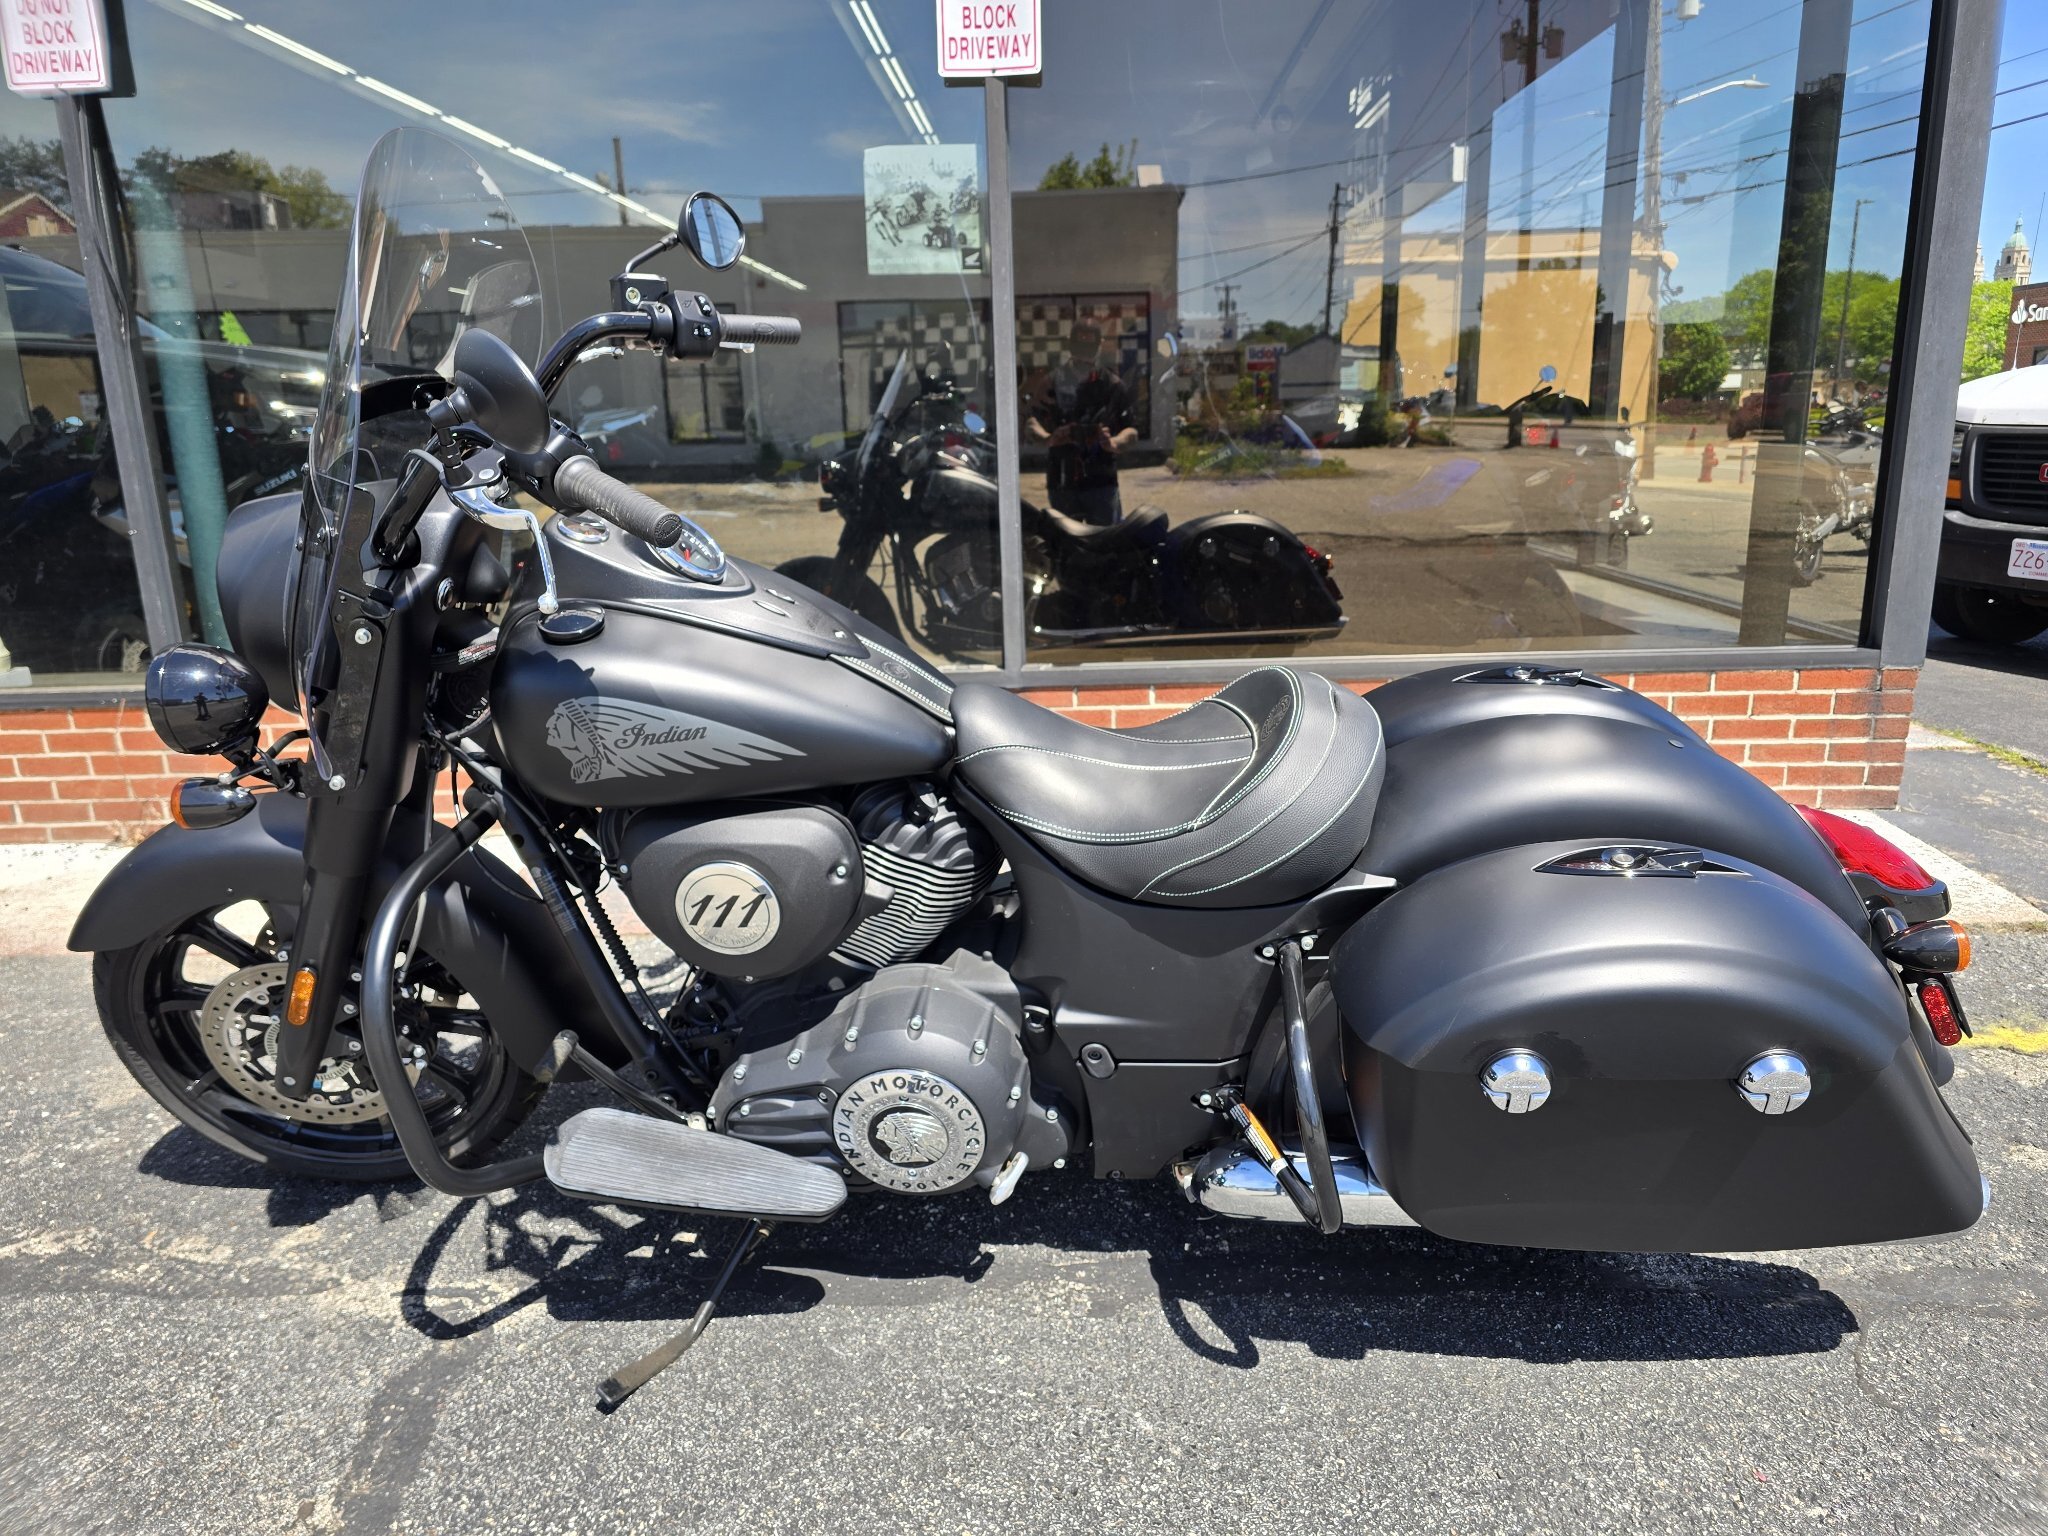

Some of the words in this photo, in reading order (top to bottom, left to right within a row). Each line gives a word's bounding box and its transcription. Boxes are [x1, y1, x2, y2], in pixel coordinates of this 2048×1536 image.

[962, 4, 1016, 29] BLOCK
[22, 20, 76, 44] BLOCK
[948, 33, 1031, 60] DRIVEWAY
[12, 49, 92, 74] DRIVEWAY
[254, 468, 298, 496] SUZUKI
[2012, 549, 2048, 569] Z26
[613, 722, 708, 749] Indian
[688, 894, 767, 928] 111
[839, 1091, 867, 1168] INDIAN
[870, 1075, 980, 1172] MOTORCYCLE
[889, 1179, 940, 1190] 1901
